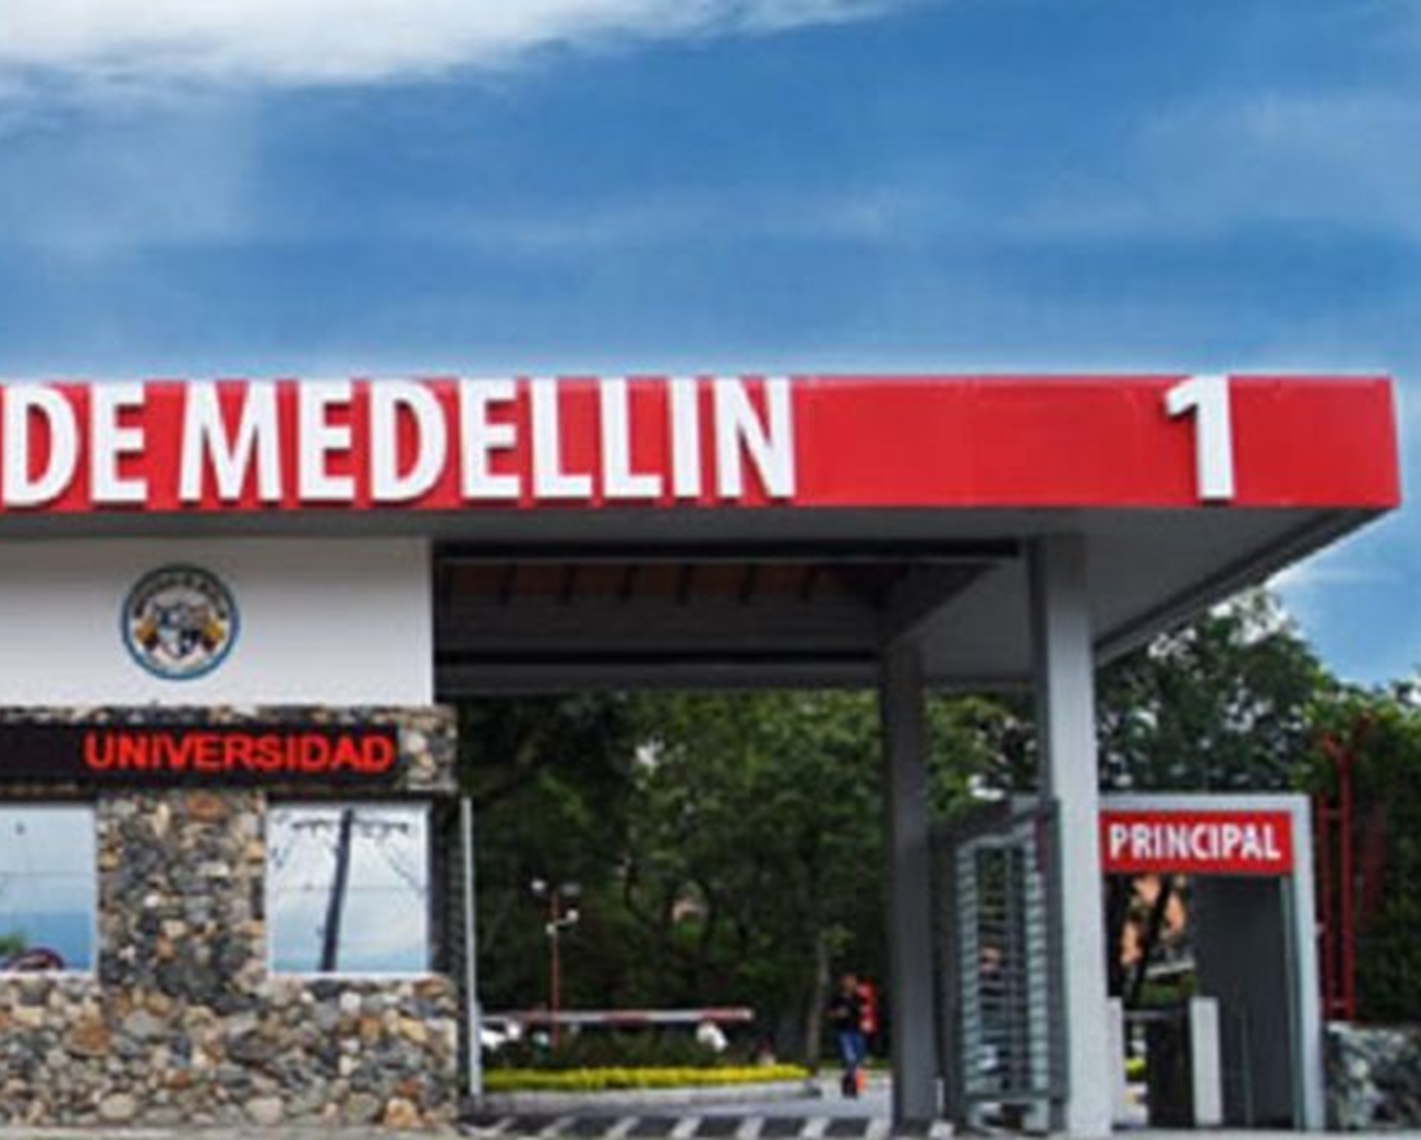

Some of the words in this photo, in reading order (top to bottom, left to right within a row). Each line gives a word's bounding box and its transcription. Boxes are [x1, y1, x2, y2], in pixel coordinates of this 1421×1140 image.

[0, 380, 148, 508] DE
[179, 376, 796, 502] MEDELLIN
[1164, 374, 1236, 499] 1
[84, 733, 397, 773] UNIVERSIDAD
[1108, 823, 1282, 861] PRINCIPAL
